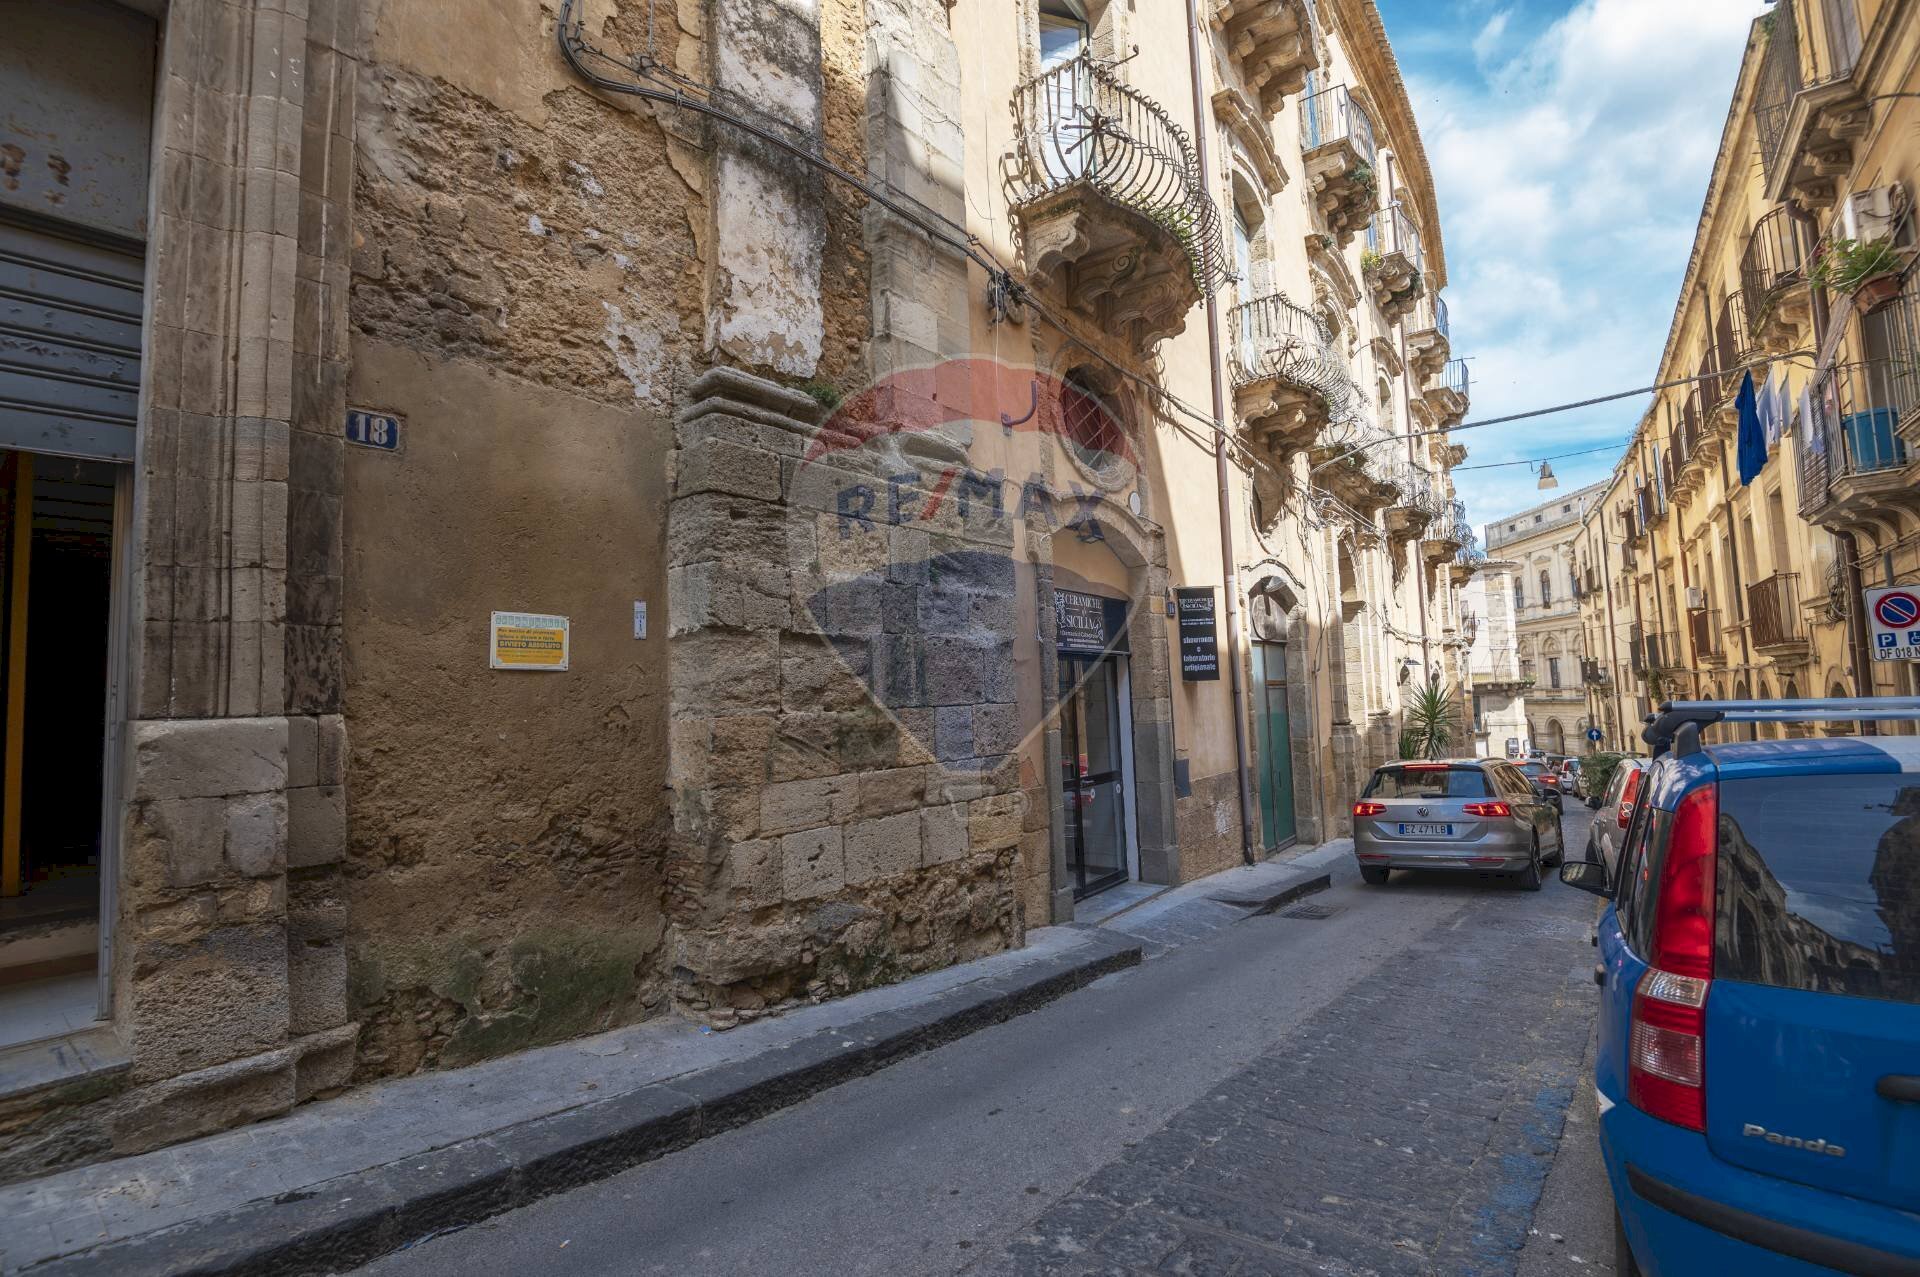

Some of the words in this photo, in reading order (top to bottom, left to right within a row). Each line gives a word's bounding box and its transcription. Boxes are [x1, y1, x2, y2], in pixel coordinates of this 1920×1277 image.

[355, 414, 388, 444] 18
[1066, 615, 1095, 629] SICILIA
[1882, 635, 1892, 646] P
[1880, 648, 1892, 658] DF
[1895, 647, 1912, 658] 018
[1405, 824, 1415, 833] EZ
[1742, 1122, 1846, 1157] Panda
